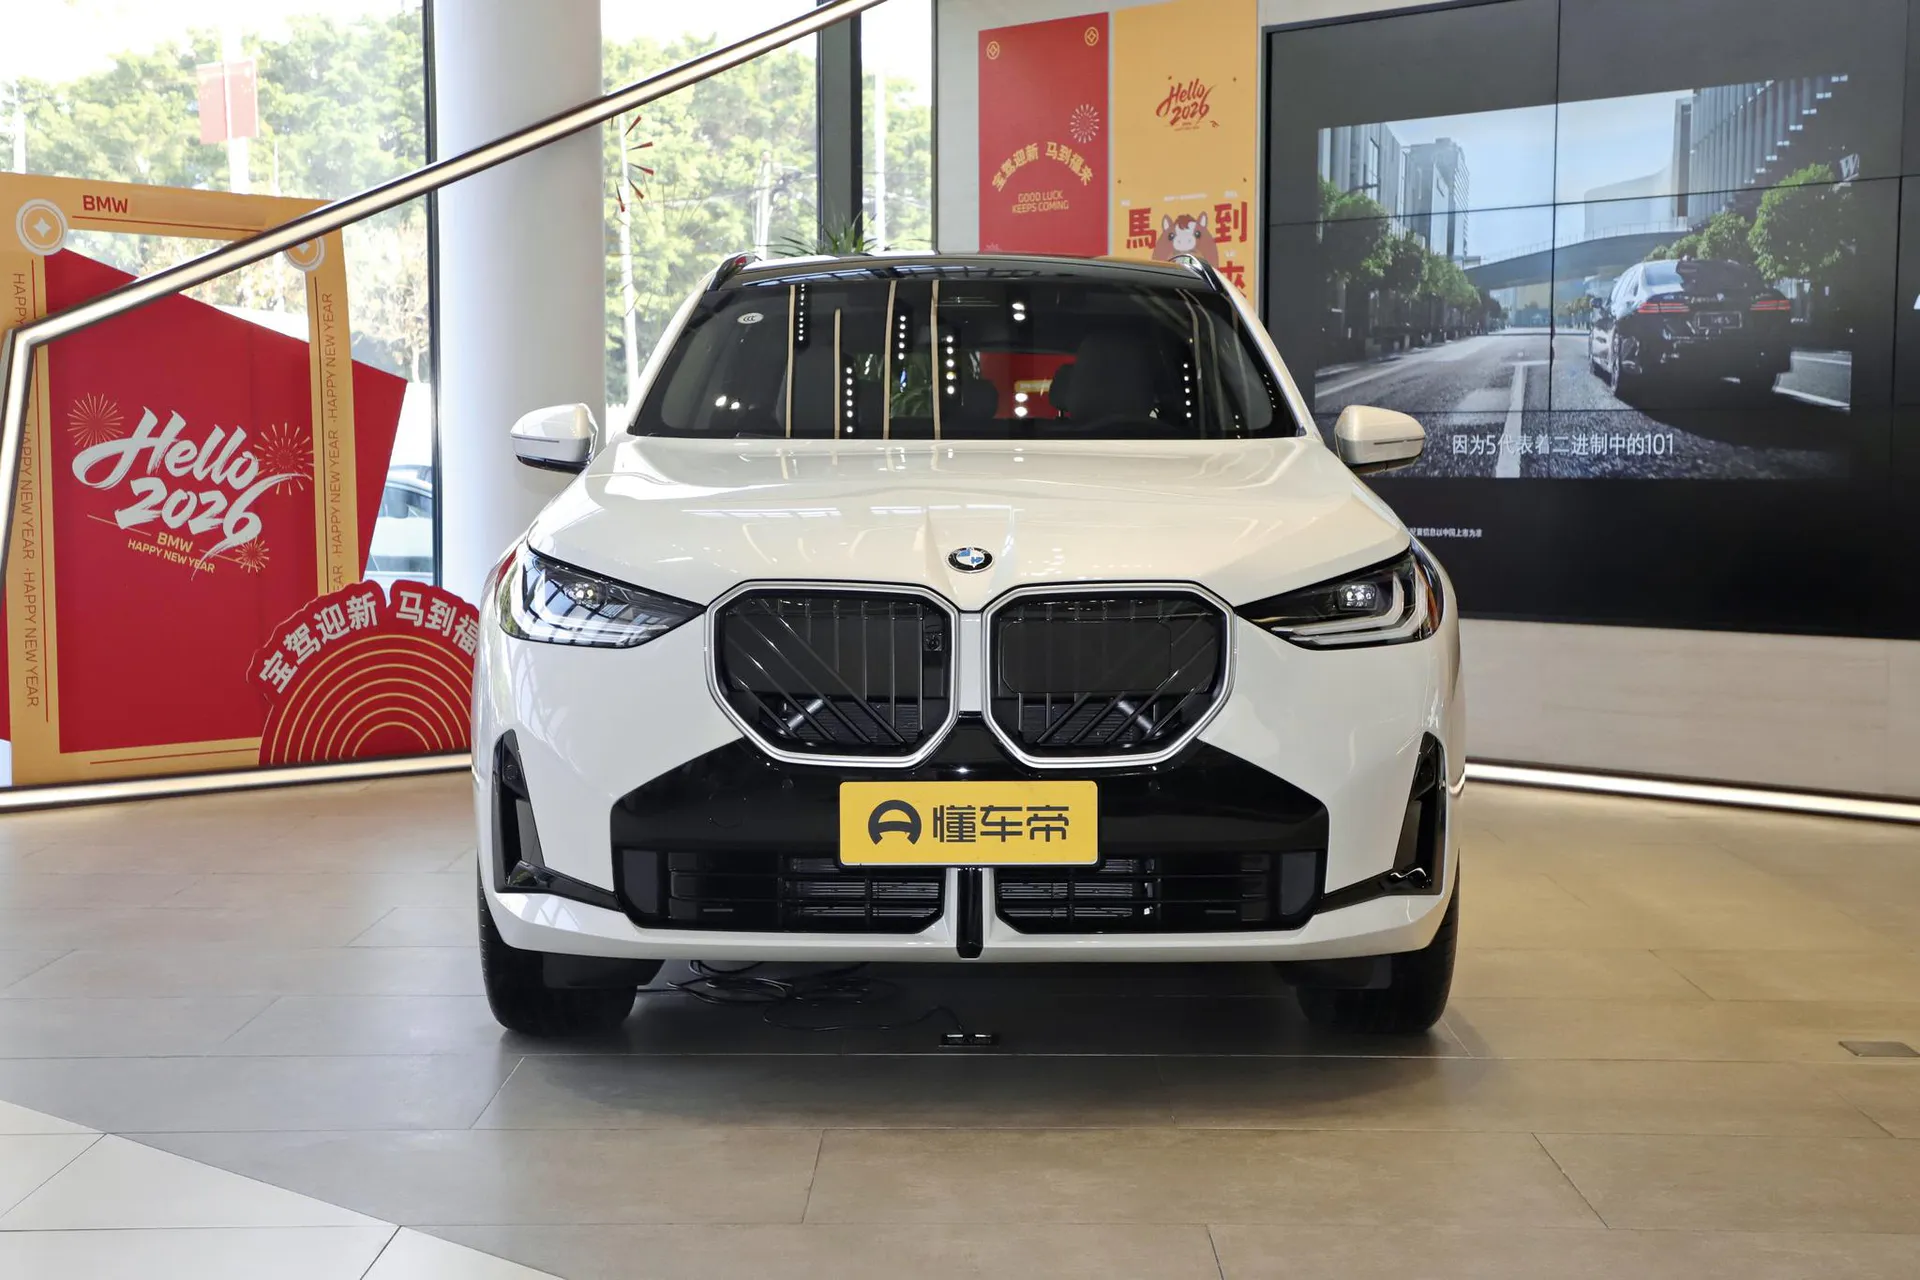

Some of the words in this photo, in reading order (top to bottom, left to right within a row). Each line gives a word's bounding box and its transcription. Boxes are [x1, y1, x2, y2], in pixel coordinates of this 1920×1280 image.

[1155, 78, 1206, 117] Hello
[1169, 85, 1217, 126] 2026
[82, 194, 129, 214] BMW
[1012, 202, 1037, 214] KEEPS
[1038, 200, 1069, 212] COMING
[1018, 191, 1041, 203] GOOD
[1042, 189, 1064, 201] LUCK
[13, 273, 27, 325] HAPPY
[322, 292, 335, 333] YEAR
[325, 335, 337, 368] NEW
[72, 406, 260, 489] Hello
[328, 430, 340, 469] YEAR
[20, 479, 34, 515] NEW
[330, 471, 341, 502] NEW
[22, 517, 35, 560] YEAR
[114, 473, 304, 576] 2026
[157, 531, 194, 554] BMW
[128, 538, 163, 558] HAPPY
[163, 549, 189, 566] NEW
[188, 556, 216, 574] YEAR
[24, 627, 38, 663] NEW
[258, 591, 378, 695] 宝驾迎新
[25, 665, 39, 708] YEAR
[932, 804, 1070, 843] 懂车帝
